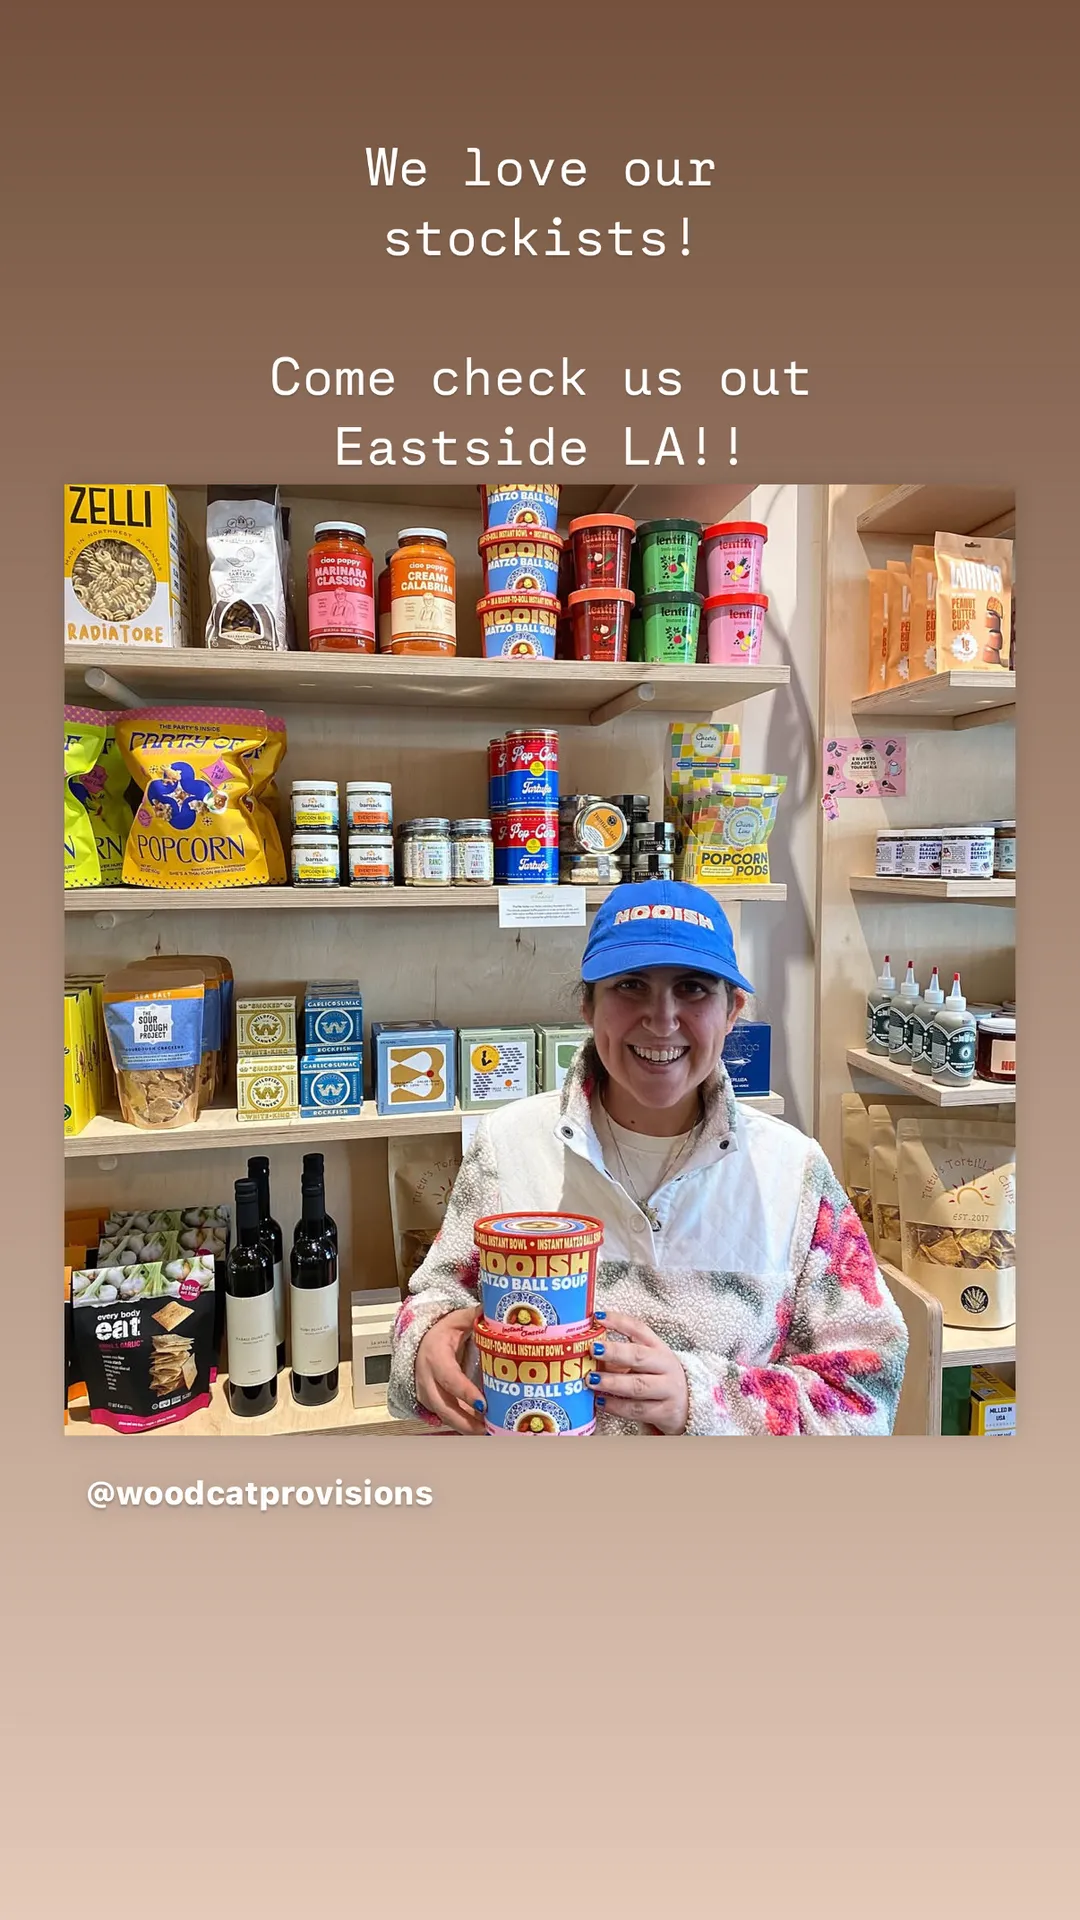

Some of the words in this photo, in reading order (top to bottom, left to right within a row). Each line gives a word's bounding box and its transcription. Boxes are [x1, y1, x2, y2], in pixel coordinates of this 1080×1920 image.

[521, 492, 543, 502] BALL
[69, 486, 152, 527] ZELLI
[66, 547, 76, 565] MADE
[88, 529, 132, 538] NORTHWEST
[136, 538, 162, 571] ARKANSAS
[486, 542, 560, 564] NOOISH
[488, 558, 518, 570] MATZO
[520, 558, 543, 567] BALL
[315, 566, 367, 579] MARINARA
[408, 572, 448, 583] CREAMY
[950, 561, 1001, 593] WHIMS
[317, 576, 366, 588] CLASSICO
[401, 582, 453, 595] CALABRIAN
[952, 598, 976, 608] PEANUT
[484, 608, 557, 628] NOOISH
[952, 609, 976, 619] BUTTER
[485, 624, 514, 636] MATZO
[515, 624, 539, 633] BALL
[952, 620, 970, 631] CUPS
[130, 732, 211, 752] PARTY
[213, 736, 246, 750] OF
[210, 772, 225, 780] Thai
[138, 834, 245, 864] POPCORN
[702, 852, 768, 865] POPCORN
[736, 864, 768, 876] PODS
[613, 904, 714, 931] NOOISH
[138, 1016, 157, 1024] SOUR
[254, 1014, 278, 1022] WILDFISH
[144, 1024, 168, 1032] DOUGH
[255, 1077, 280, 1086] WILDFISH
[433, 1158, 459, 1171] Tort
[488, 1238, 508, 1249] INSTANT
[509, 1238, 527, 1250] BOWL
[537, 1238, 563, 1250] INSTANT
[564, 1235, 583, 1248] MATZO
[181, 1284, 199, 1292] baked
[512, 1279, 548, 1291] BALL
[552, 1274, 588, 1290] SOUP
[97, 1312, 119, 1321] every
[120, 1309, 141, 1318] body
[95, 1317, 141, 1340] eat
[501, 1326, 523, 1334] Instant
[120, 1340, 141, 1348] GARLIC
[481, 1338, 516, 1355] READY-TO-ROLL
[518, 1343, 544, 1357] INSTANT
[545, 1344, 565, 1356] BOWL
[481, 1350, 597, 1384] NOOISH
[483, 1374, 520, 1396] MATZO
[524, 1384, 562, 1397] BALL
[990, 1406, 1007, 1414] MILLED
